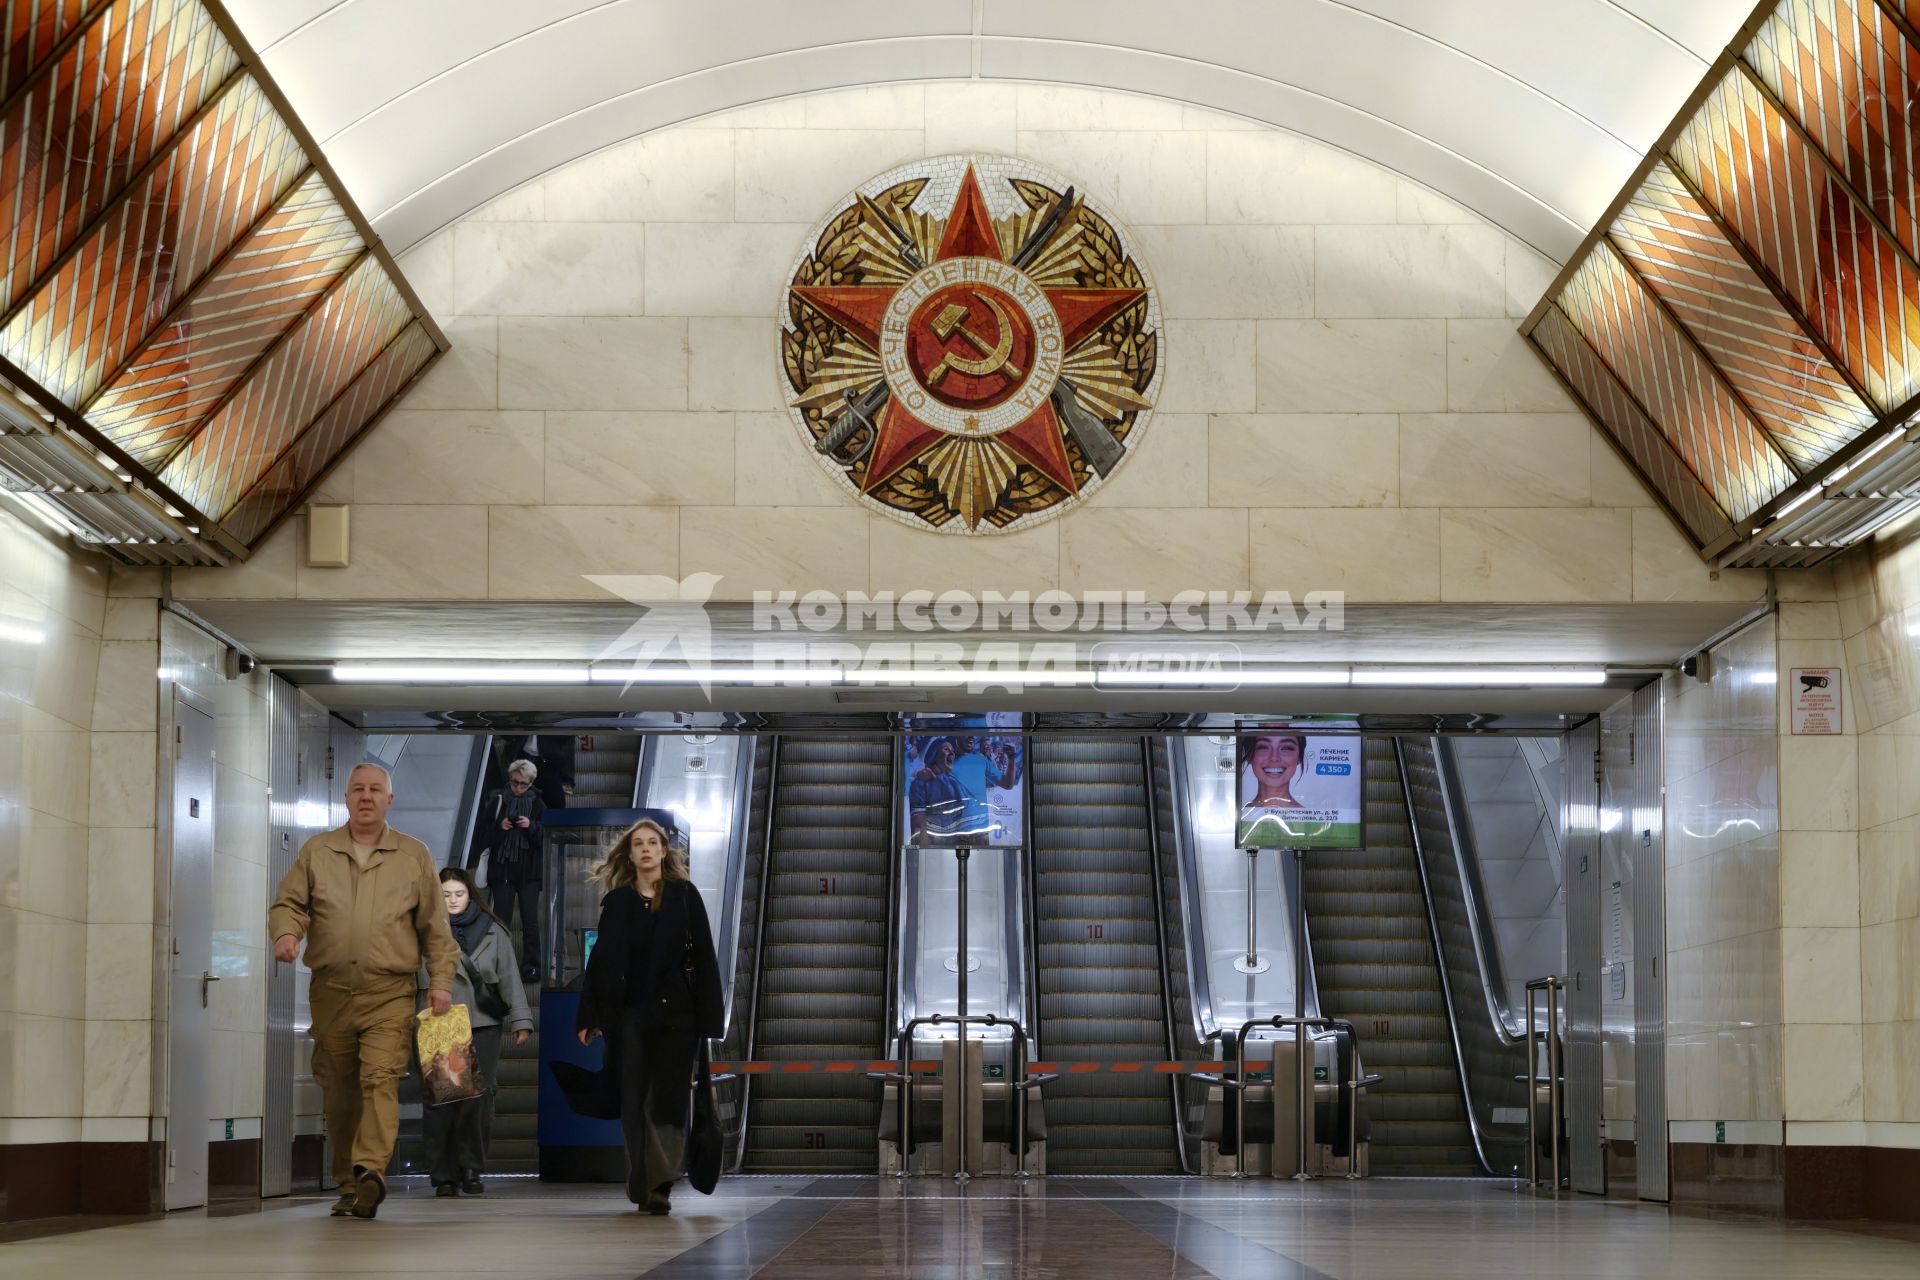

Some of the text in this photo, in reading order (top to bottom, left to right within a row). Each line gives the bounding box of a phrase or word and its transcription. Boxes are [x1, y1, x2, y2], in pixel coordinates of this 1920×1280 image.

[884, 260, 1040, 410] ОТЕЧЕСТВЕННАЯ
[1320, 765, 1326, 773] 4
[1328, 765, 1343, 773] 350
[819, 877, 836, 895] 31
[1087, 924, 1103, 939] 10
